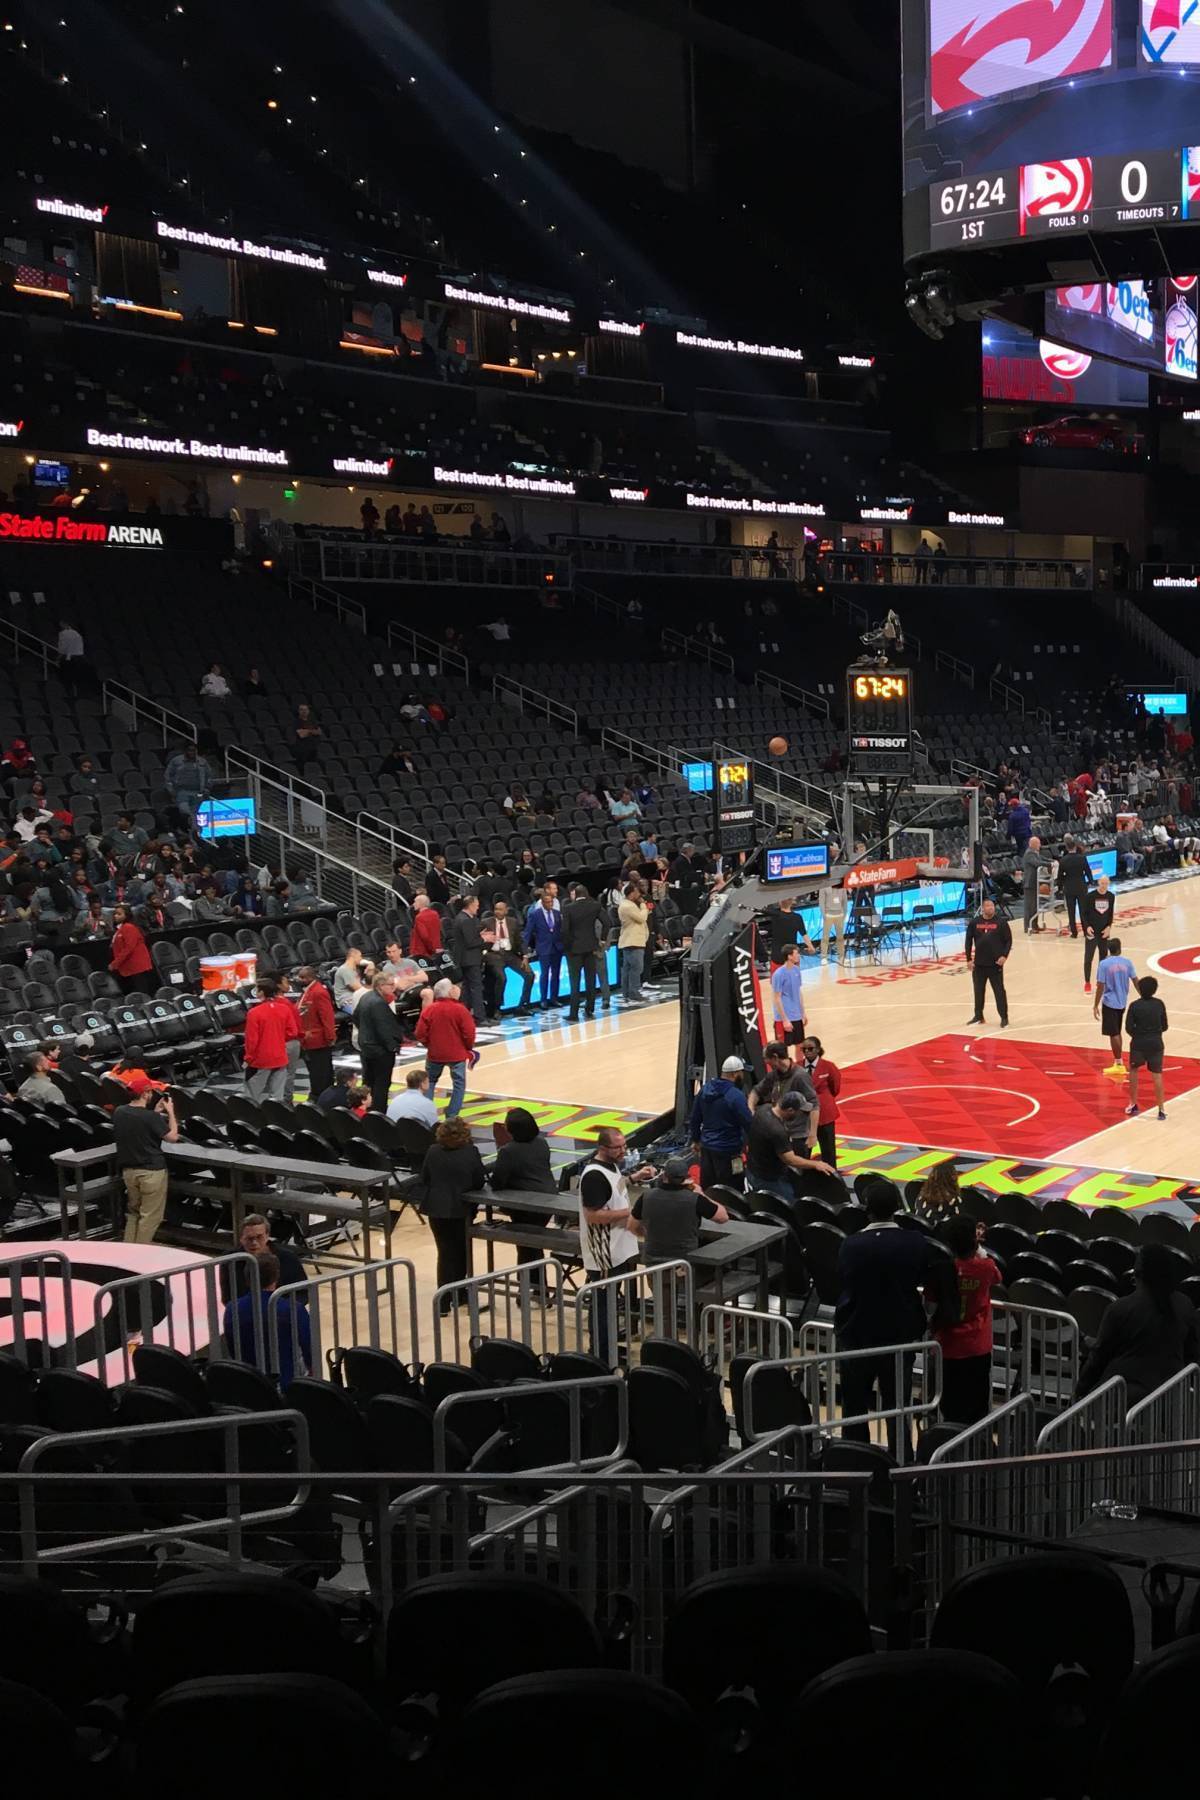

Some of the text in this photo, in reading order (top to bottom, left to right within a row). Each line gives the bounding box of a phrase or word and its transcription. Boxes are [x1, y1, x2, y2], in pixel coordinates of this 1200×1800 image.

[1121, 160, 1148, 203] 0
[940, 177, 1006, 215] 67:24
[37, 199, 102, 222] unlimited
[1116, 206, 1179, 220] TIMEOUTS 7
[961, 221, 985, 240] 1ST
[1049, 214, 1089, 228] FOULS 0
[158, 222, 326, 270] Best network. Best unlimited.
[367, 270, 403, 286] verizon
[445, 284, 570, 322] Best network. Best unlimited.
[599, 320, 641, 335] unlimited
[677, 332, 803, 359] Best network. Best unlimited.
[839, 356, 871, 367] verizon
[88, 429, 288, 464] Best network. Best unlimited.
[334, 458, 388, 475] unlimited
[434, 467, 575, 494] Best network. Best unlimited.
[610, 488, 644, 500] verizon
[687, 494, 825, 515] Best network. Best unlimited.
[861, 508, 907, 520] unlimited
[949, 512, 971, 523] Best
[0, 513, 163, 544] State Farm ARENA
[1153, 577, 1197, 587] unlimited
[856, 677, 903, 698] 67:24
[867, 737, 907, 748] TISSOT
[733, 946, 760, 1033] xfinity
